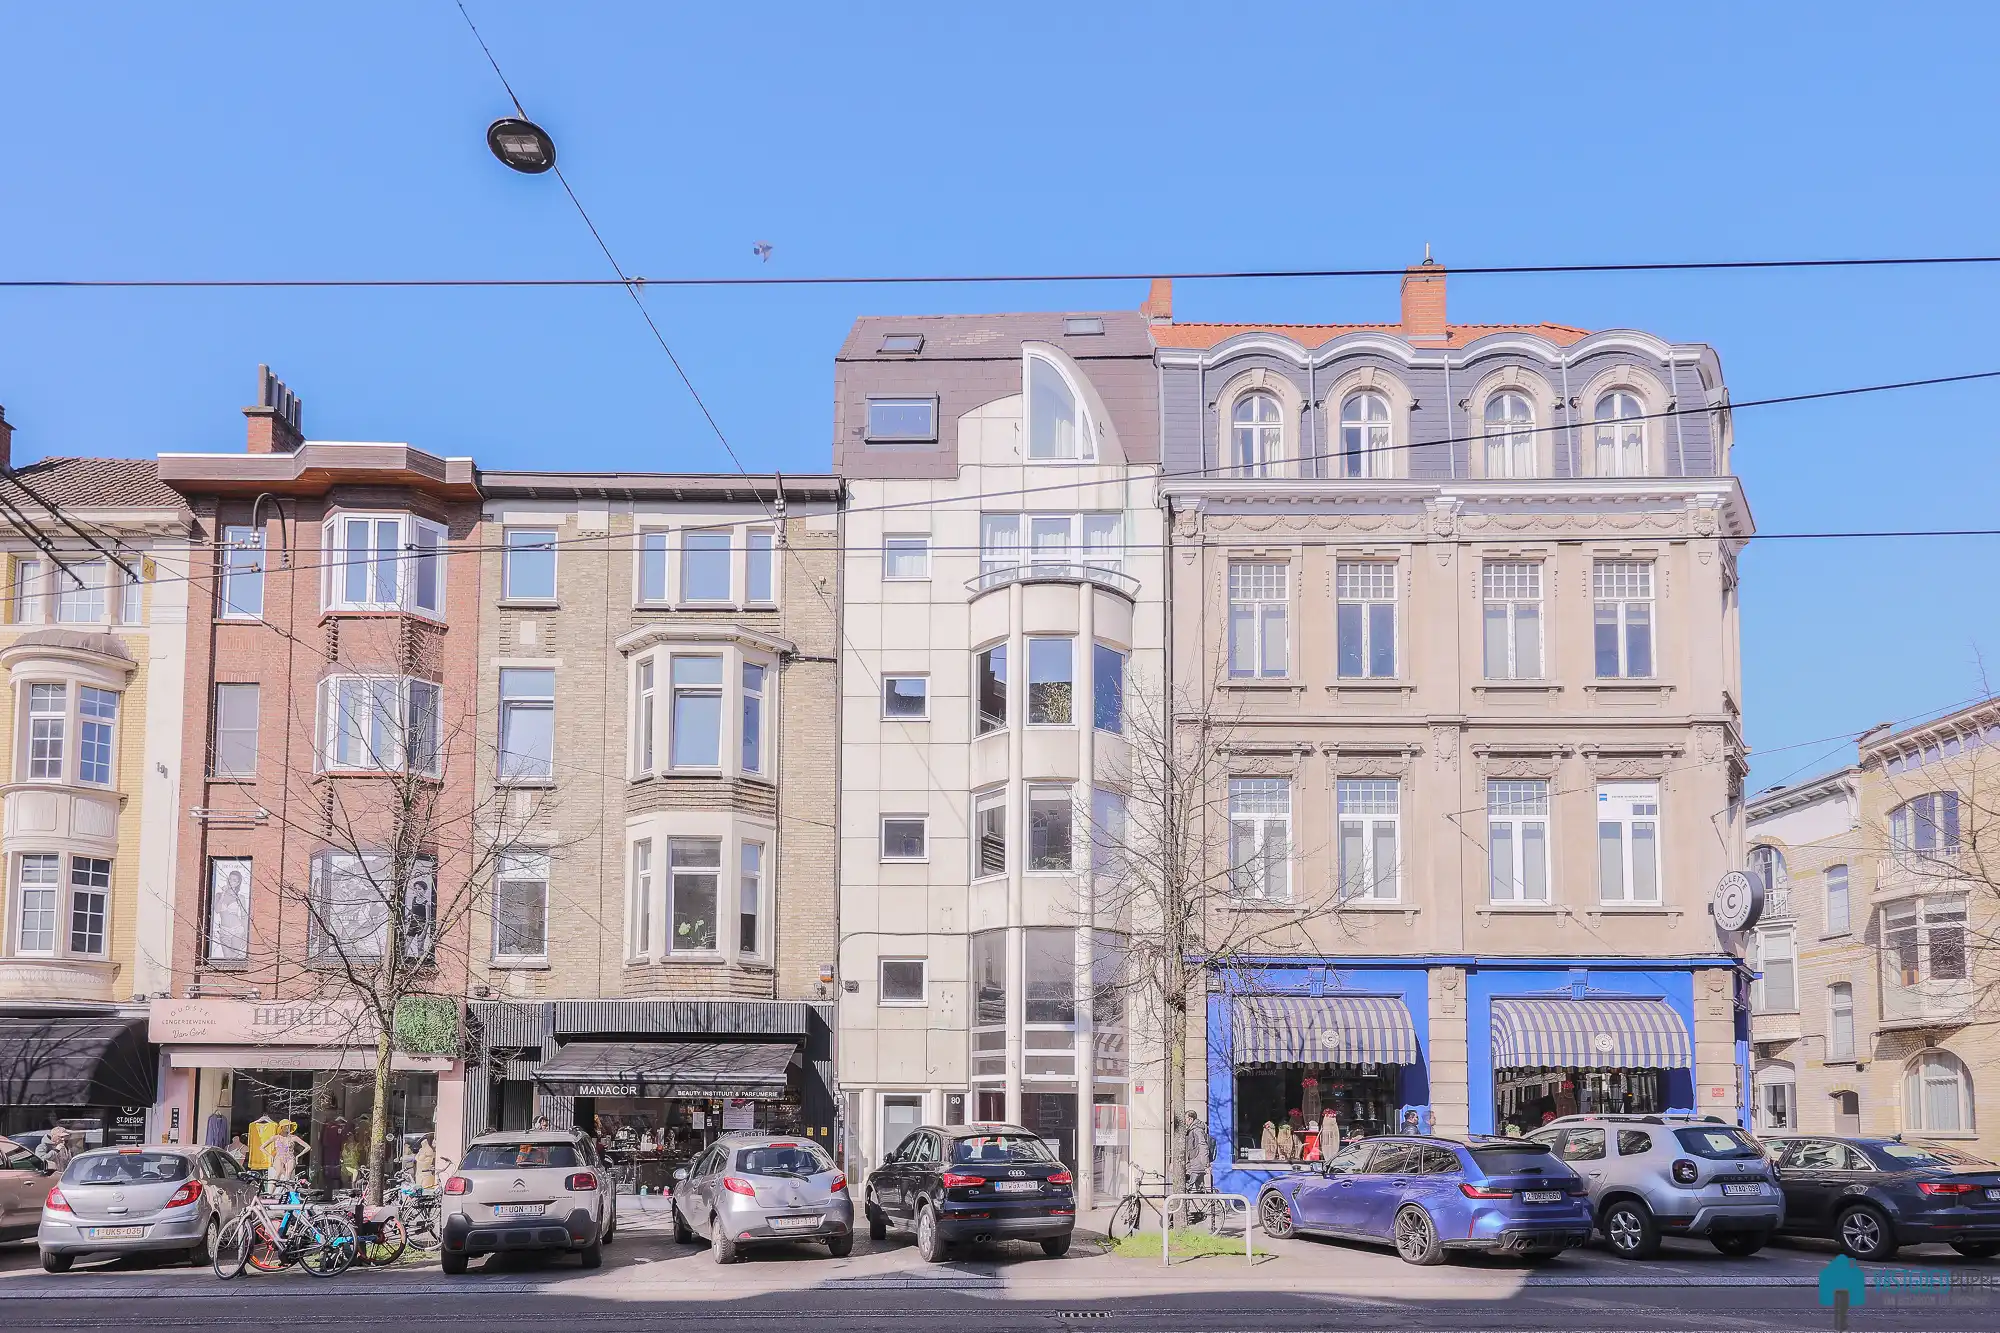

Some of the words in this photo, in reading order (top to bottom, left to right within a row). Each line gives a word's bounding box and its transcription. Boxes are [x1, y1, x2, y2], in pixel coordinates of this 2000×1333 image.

[1716, 875, 1748, 898] COLLETTE
[1727, 893, 1737, 909] C
[579, 1085, 637, 1095] MANACOR
[950, 1096, 961, 1104] 80
